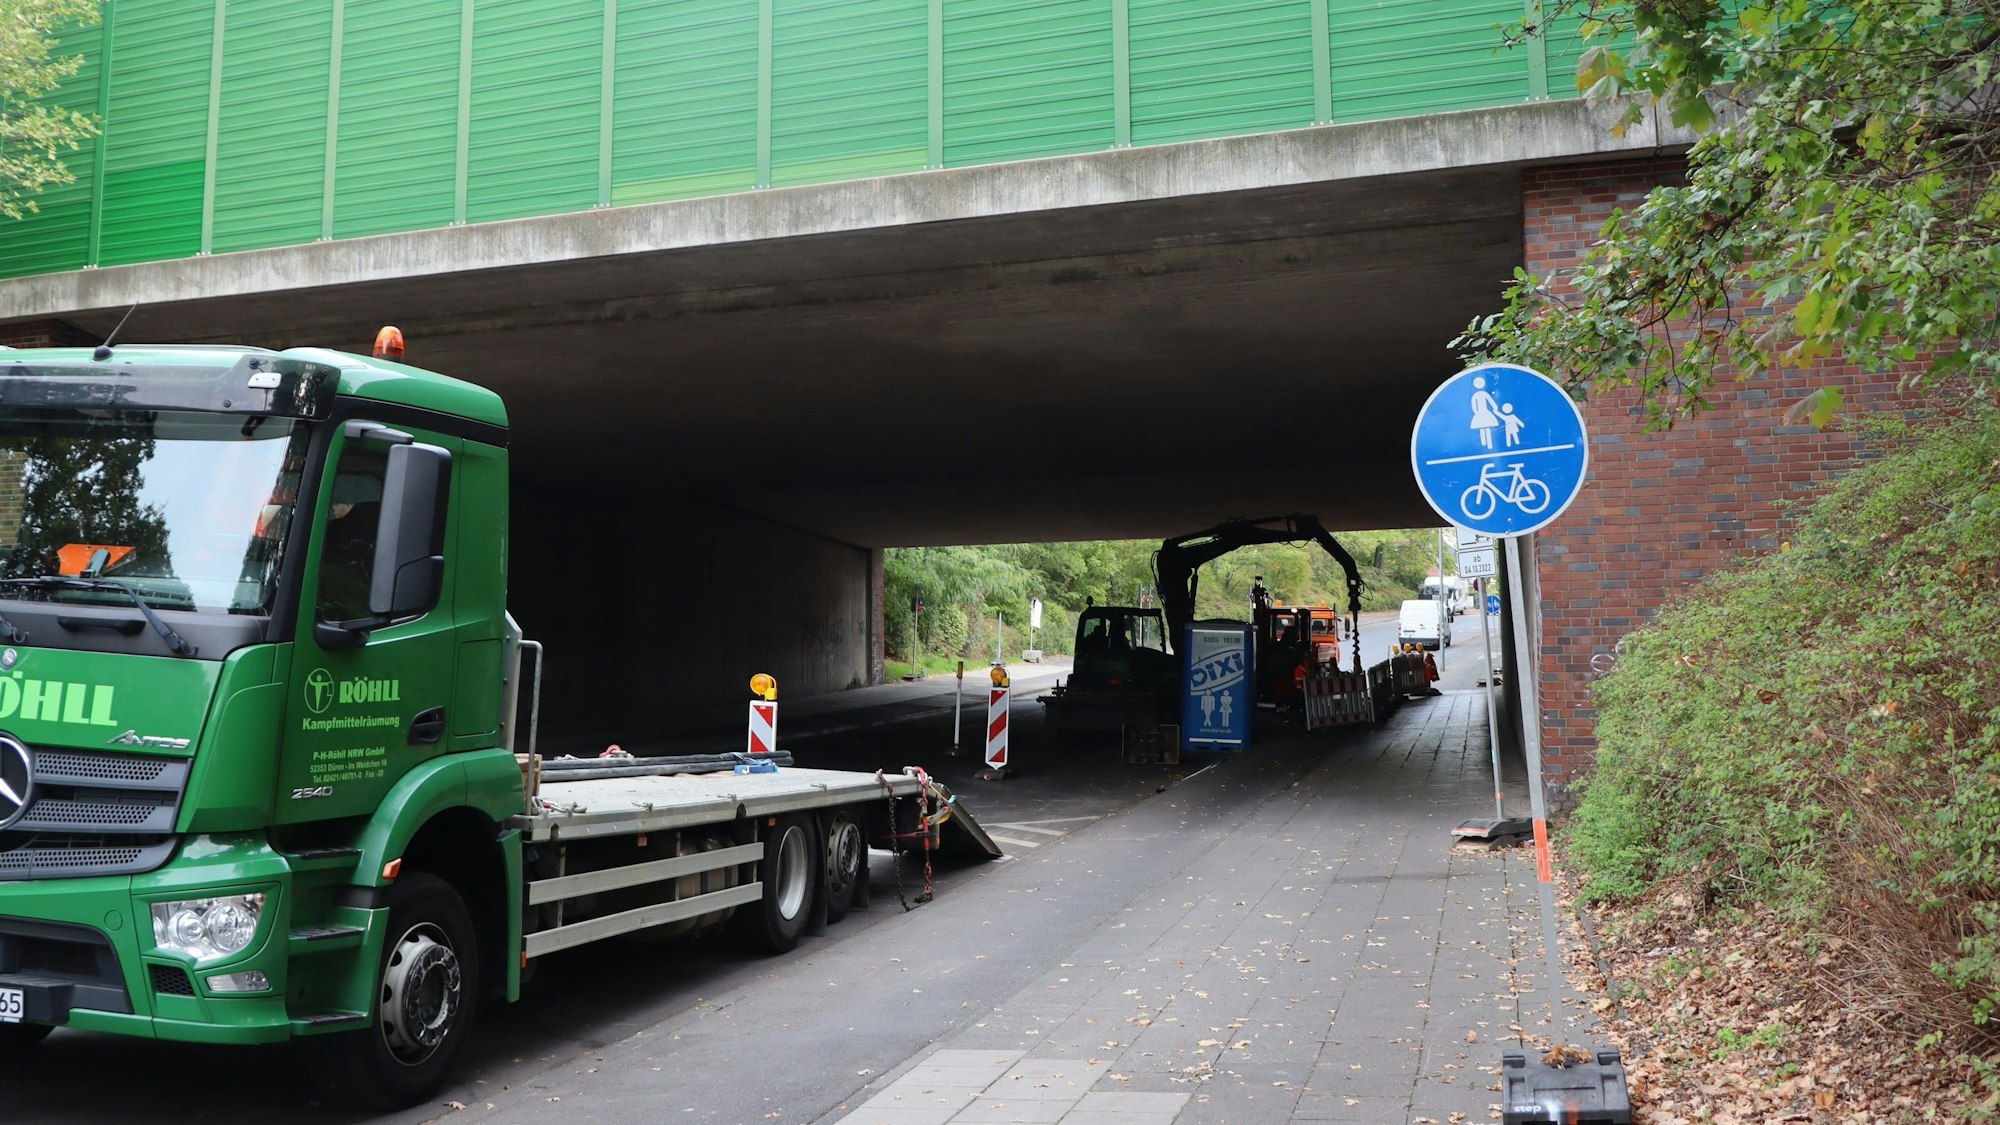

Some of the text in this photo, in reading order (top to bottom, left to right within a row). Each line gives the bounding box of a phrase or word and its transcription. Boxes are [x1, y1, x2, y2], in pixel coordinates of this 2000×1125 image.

[1472, 554, 1482, 563] ab
[1464, 563, 1492, 574] 04.10.2022
[339, 676, 400, 703] RÖHLL
[302, 716, 400, 731] Kampfmittelräumung
[313, 747, 385, 761] P-H-Röhll NRW GmbH
[310, 763, 327, 773] 52353
[327, 762, 345, 772] Düren
[347, 761, 356, 770] Im
[356, 759, 381, 770] Weidchen
[313, 775, 322, 784] Tel.
[364, 769, 375, 779] Fax
[291, 785, 334, 800] 2540
[0, 991, 21, 1014] 65
[1514, 1105, 1542, 1115] step
